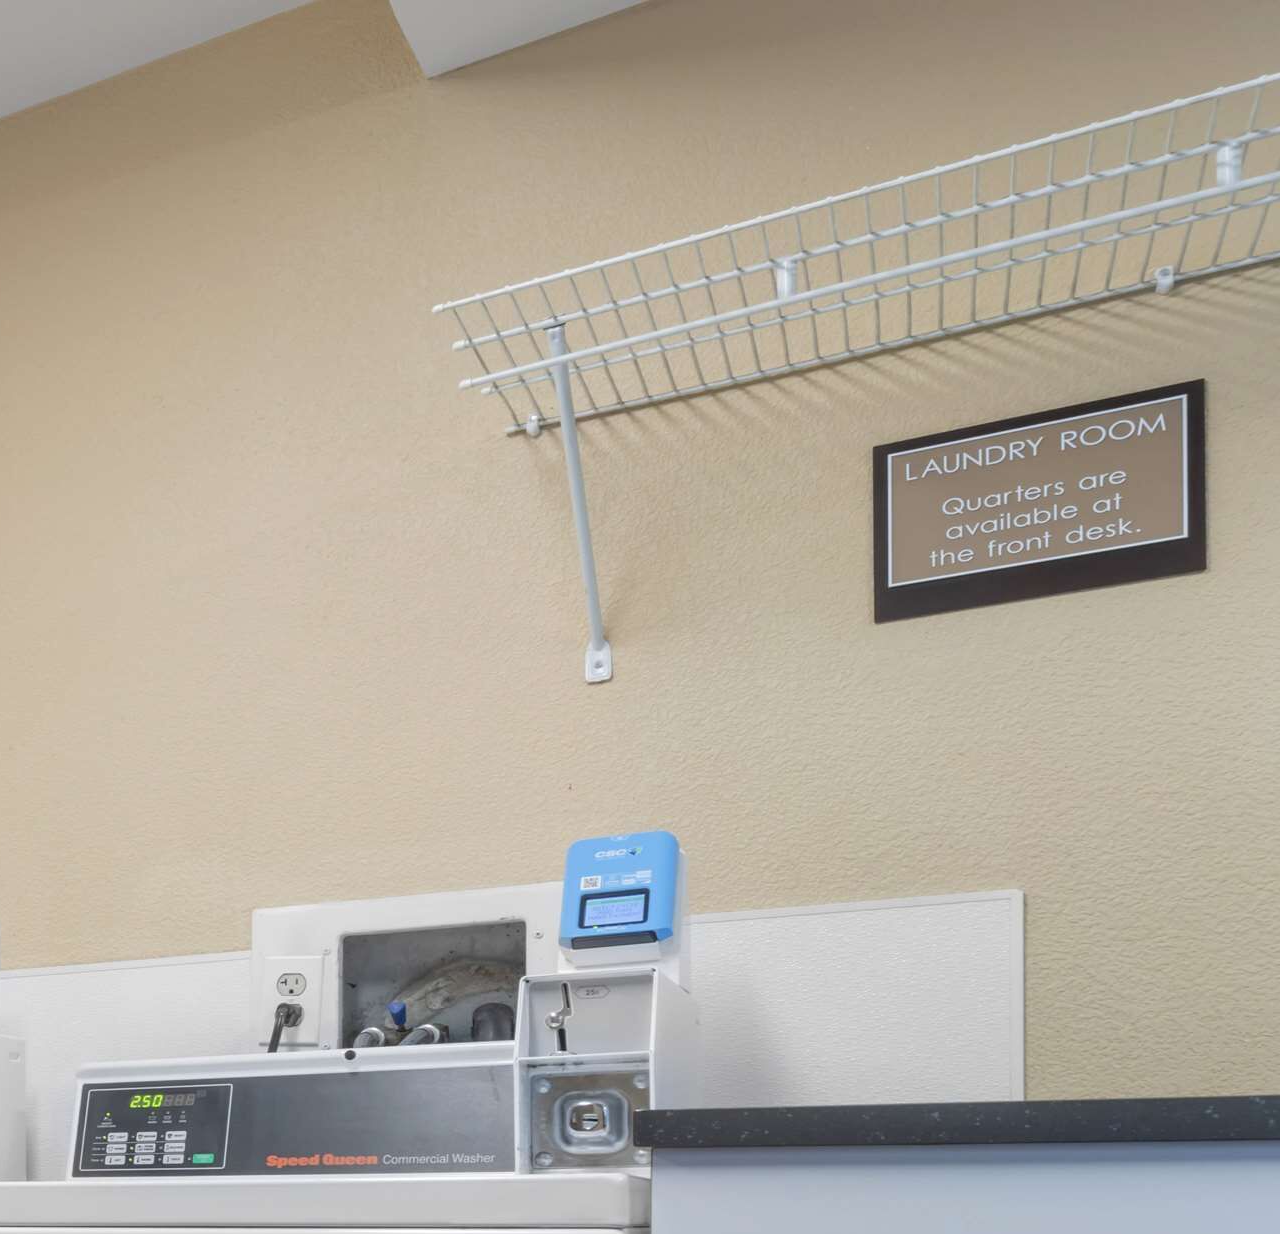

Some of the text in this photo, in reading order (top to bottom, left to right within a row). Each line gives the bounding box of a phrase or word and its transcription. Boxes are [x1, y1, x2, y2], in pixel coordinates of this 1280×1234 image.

[904, 413, 1167, 480] LAUNDRY ROOM
[942, 470, 1127, 515] Quarters are
[945, 493, 1123, 540] available at
[929, 518, 1142, 567] the front desk.
[129, 1094, 163, 1108] 2.50
[265, 1152, 496, 1168] Speed Queen Commercial Washer
